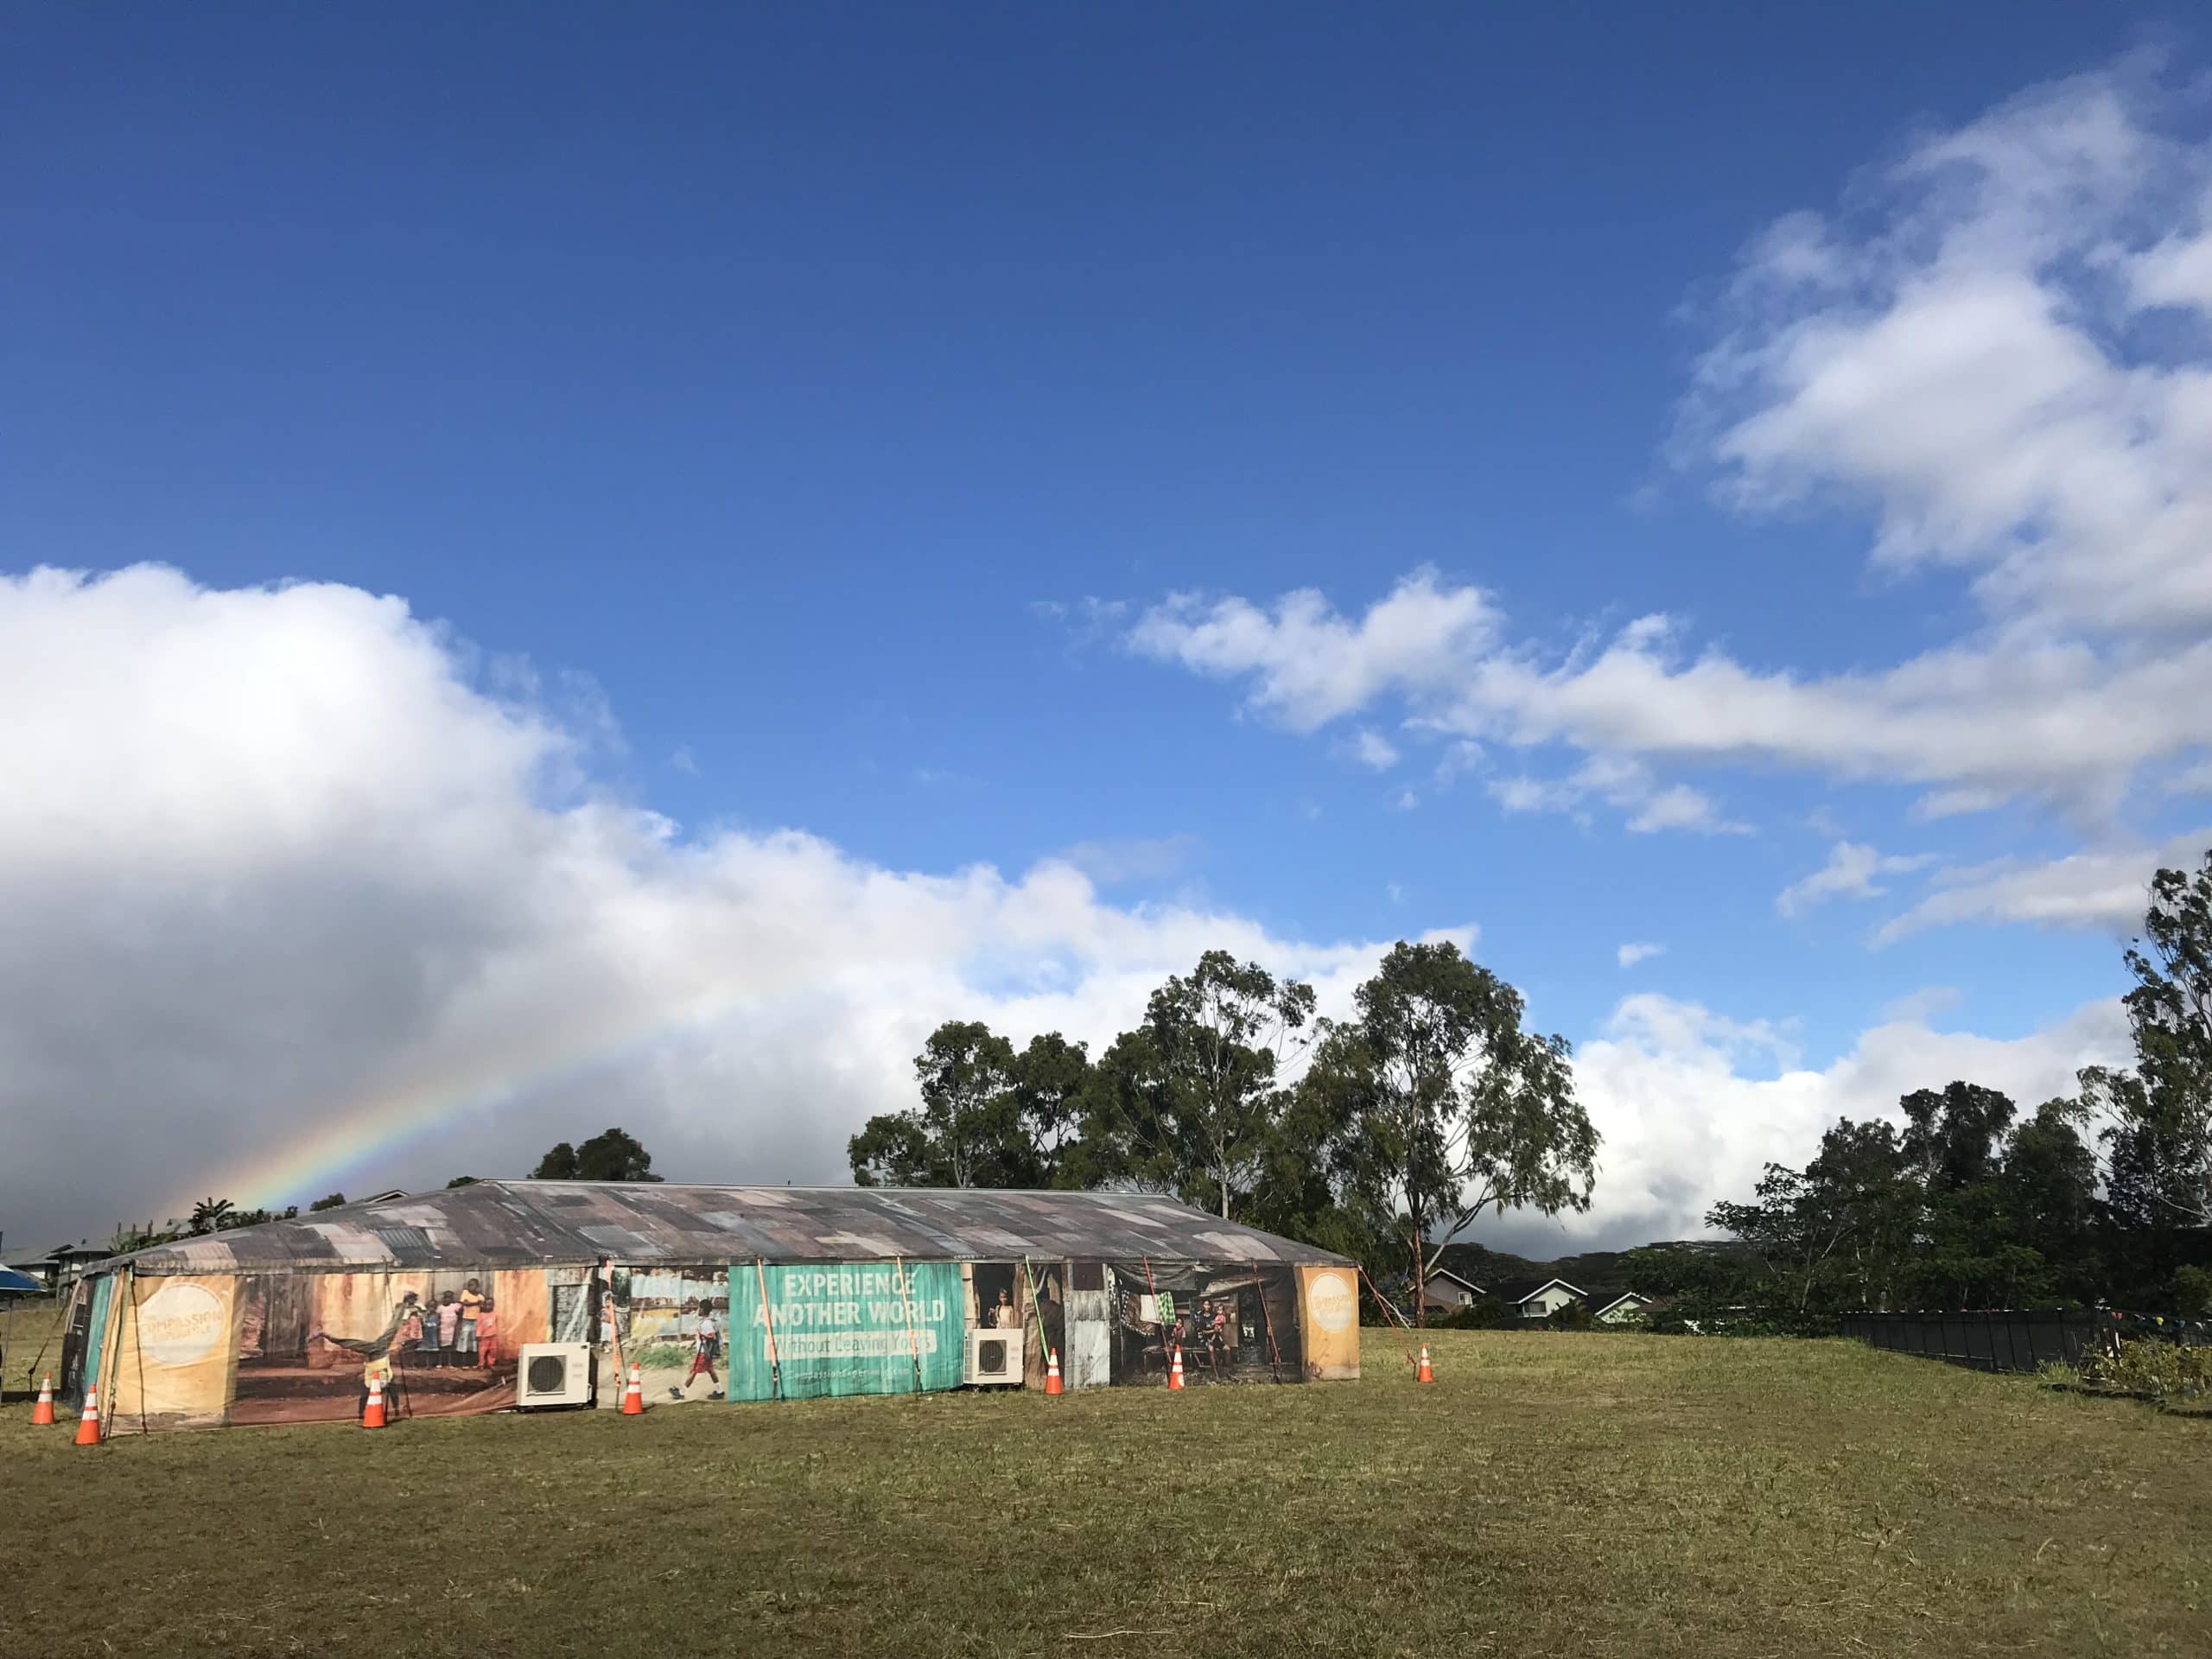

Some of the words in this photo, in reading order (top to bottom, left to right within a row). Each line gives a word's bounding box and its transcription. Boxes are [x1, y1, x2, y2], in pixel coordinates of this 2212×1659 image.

[785, 1273, 917, 1297] EXPERIENCE
[753, 1302, 861, 1328] ANOTHER
[868, 1300, 945, 1324] WORLD
[774, 1334, 830, 1354] Without
[835, 1333, 887, 1354] Leaving
